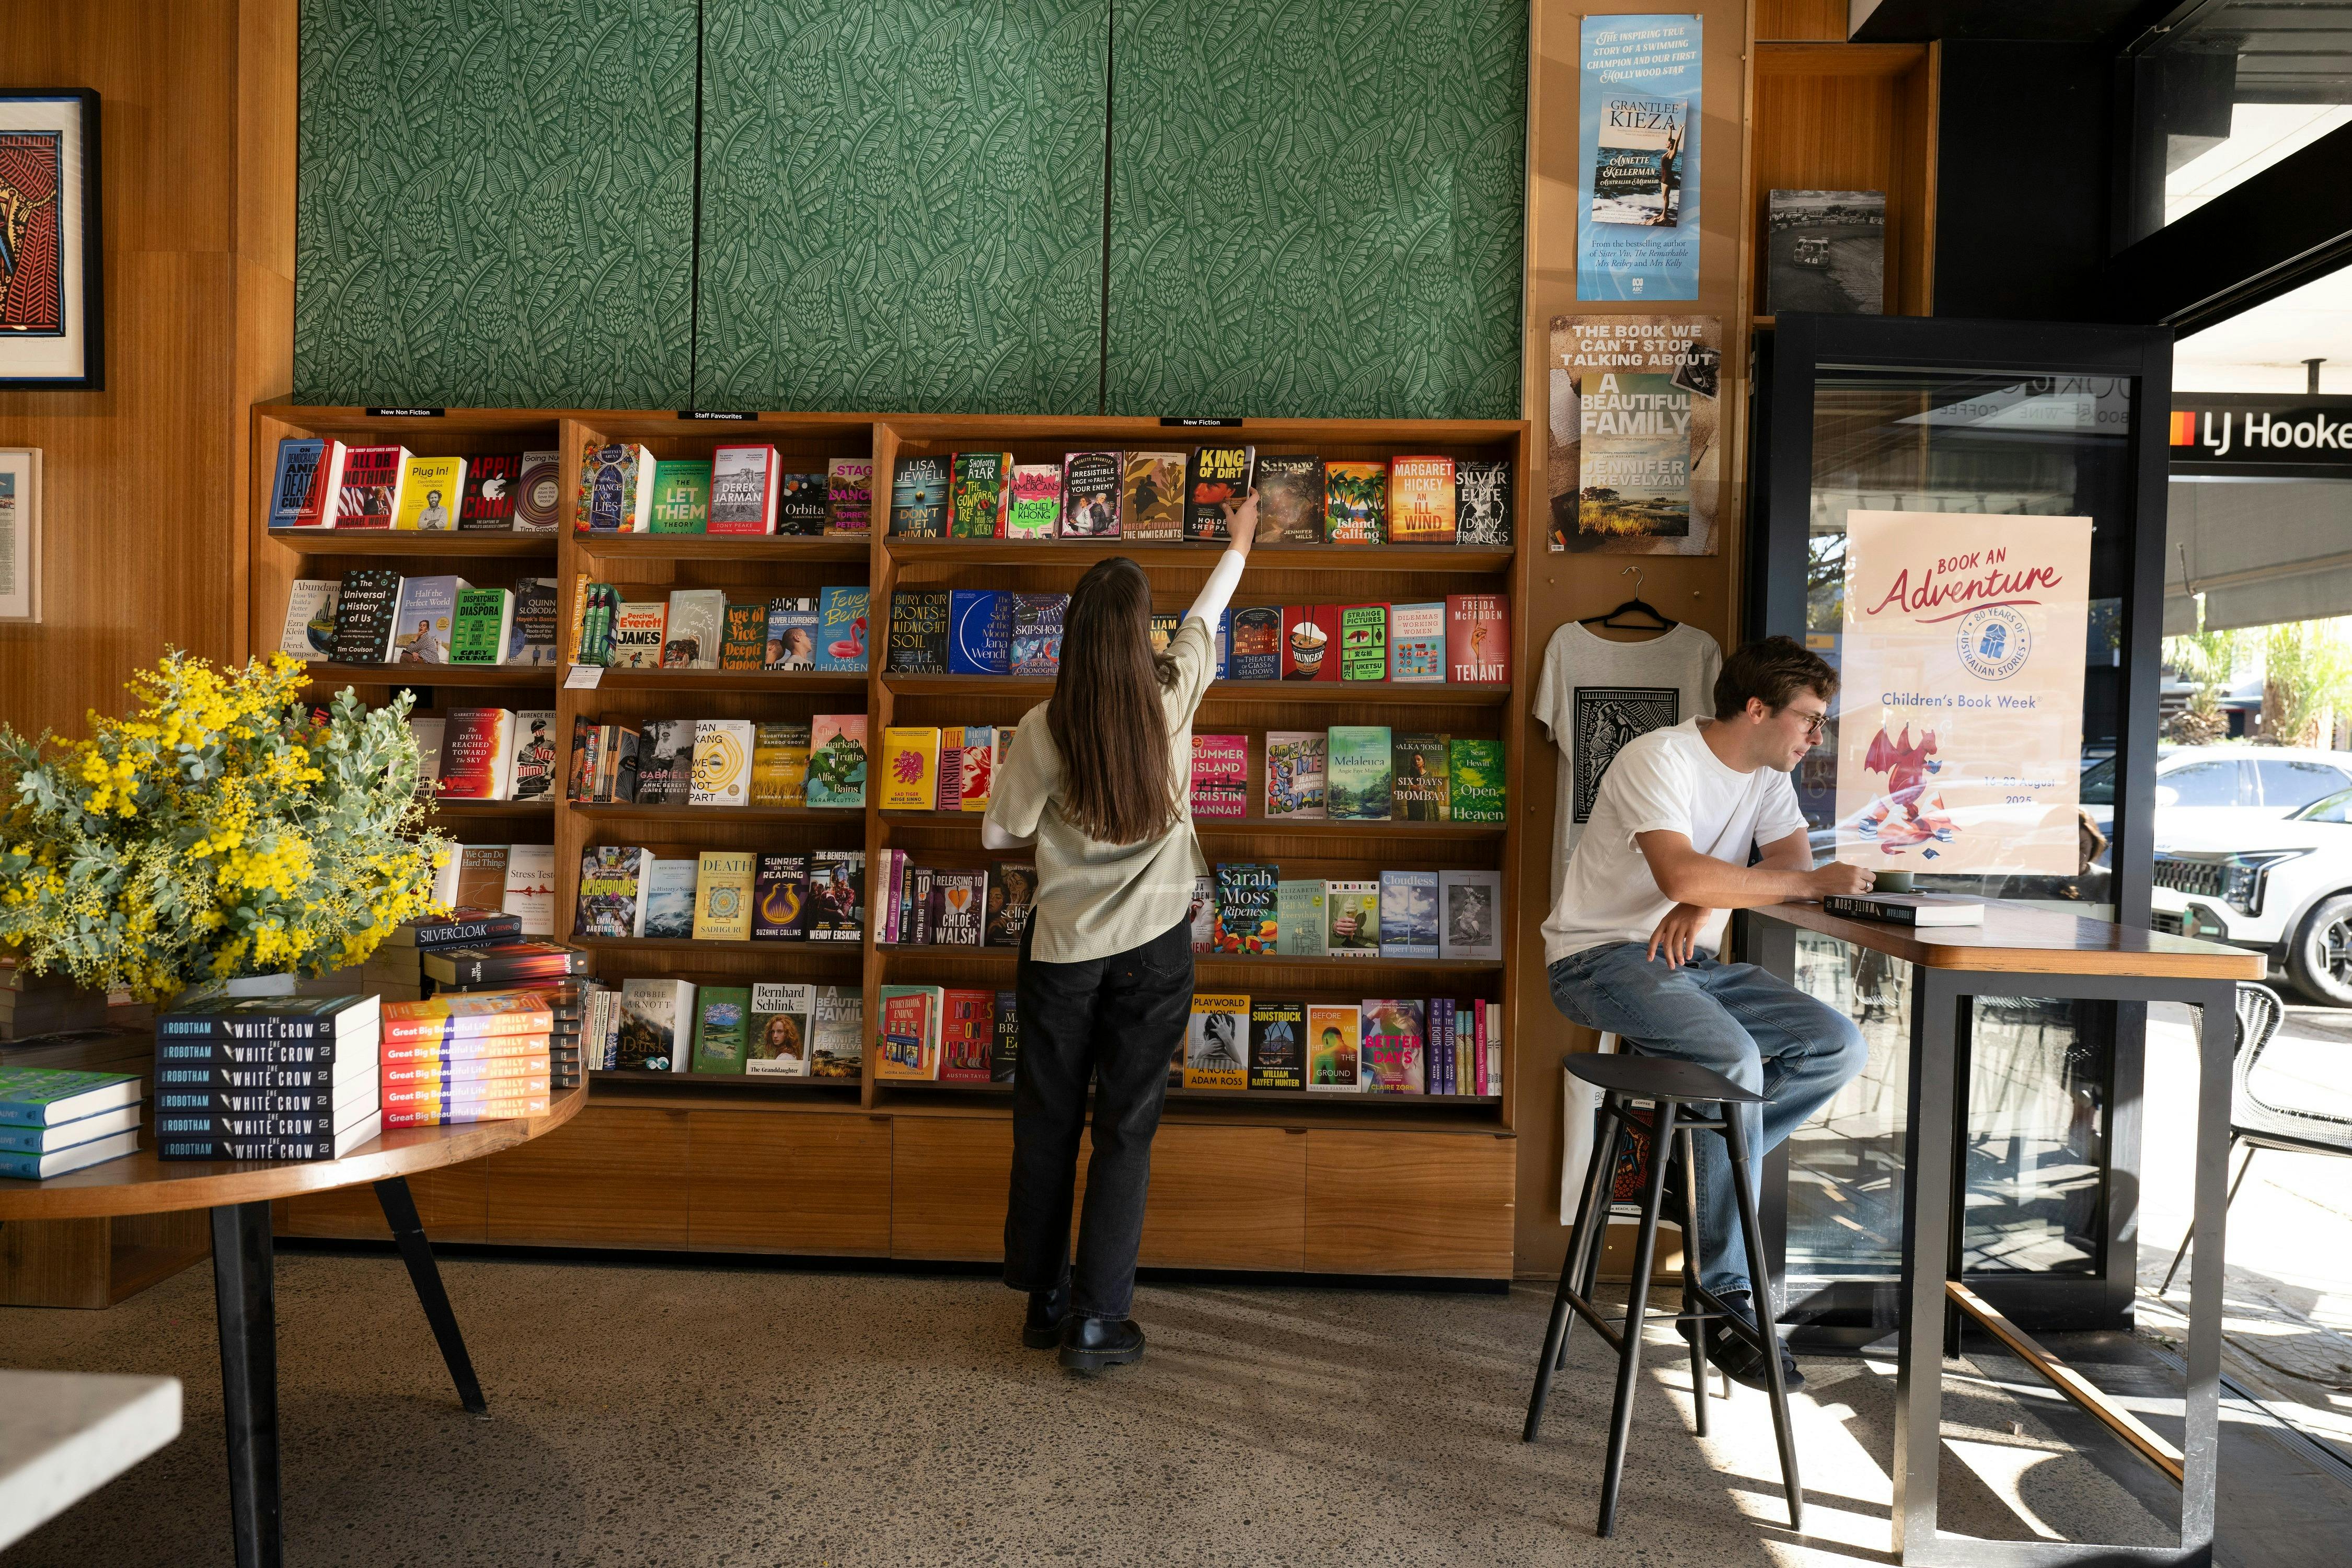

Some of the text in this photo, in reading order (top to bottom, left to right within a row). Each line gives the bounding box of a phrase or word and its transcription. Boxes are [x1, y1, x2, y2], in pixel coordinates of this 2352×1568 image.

[1620, 29, 1661, 41] INSPIRING
[1663, 27, 1685, 36] TRUE
[1594, 46, 1620, 56] STORY
[1643, 40, 1688, 51] SWIMMING
[1587, 51, 1697, 69] CHAMPION AND OUR FIRST
[1600, 65, 1685, 83] HOLLYWOOD STAR
[1611, 100, 1679, 113] GRANTLEE
[1610, 111, 1677, 130] KIEZA
[1610, 155, 1650, 167] ANNETTE
[1602, 167, 1655, 178] KELLERMAN
[1611, 259, 1632, 268] Reibey
[1666, 259, 1682, 268] Kelly
[1573, 326, 1701, 337] THE BOOK WE
[1643, 340, 1693, 352] STOP
[1561, 354, 1713, 366] TALKING ABOUT
[1599, 373, 1619, 394] A
[1581, 394, 1691, 410] BEAUTIFUL
[1581, 411, 1692, 435] FAMILY
[2204, 412, 2231, 456] LJ
[1200, 450, 1244, 467] KING
[909, 460, 936, 470] LISA
[1261, 460, 1313, 474] Salvage
[1395, 464, 1451, 476] MARGARET
[1585, 460, 1685, 474] JENNIFER
[412, 467, 448, 477] Plug In!
[897, 470, 946, 482] JEWELL
[1200, 468, 1242, 478] OF DIRT
[1404, 479, 1443, 491] HICKEY
[1585, 475, 1685, 486] TREVELYAN
[722, 483, 755, 492] DEREK
[714, 492, 762, 502] JARMAN
[1018, 511, 1050, 519] KHONG
[1938, 547, 2006, 574] BOOK AN
[344, 591, 386, 599] Universal
[1867, 567, 2063, 615] Adventure
[347, 603, 378, 612] History
[1462, 601, 1494, 610] FREIDA
[1456, 610, 1502, 620] McFADDEN
[1975, 608, 2025, 633] 80 YEARS OF
[618, 631, 661, 644] JAMES
[1294, 650, 1324, 662] HUNGER
[1962, 630, 2026, 676] AUSTRALIAN STORIES
[1455, 664, 1504, 681] TENANT
[1958, 695, 1992, 708] Book
[1192, 749, 1243, 759] SUMMER
[1194, 763, 1240, 773] ISLAND
[2020, 777, 2056, 787] August
[704, 860, 752, 872] DEATH
[937, 876, 982, 886] RELEASING 10
[1221, 869, 1272, 886] Sarah
[1383, 875, 1434, 885] Cloudless
[581, 879, 638, 896] NEIGHBOURS
[1223, 887, 1270, 905] Moss
[1835, 898, 1874, 913] WHITE CROW
[1887, 908, 1909, 919] ROBOTHAM
[420, 925, 487, 942] SILVERCLOAK
[757, 986, 804, 998] Bernhard
[756, 999, 794, 1011] Schlink
[890, 998, 920, 1009] STORYBOOK
[1194, 998, 1244, 1007] PLAYWORLD
[495, 1015, 527, 1023] EMILY
[894, 1010, 913, 1019] ENDING
[1253, 1012, 1301, 1021] SUNSTRUCK
[169, 1022, 314, 1038] ROBOTHAM WHITE CROW
[393, 1028, 418, 1036] Great
[434, 1024, 474, 1033] Beautiful
[1365, 1035, 1421, 1048] BETTER
[1374, 1051, 1412, 1063] DAYS
